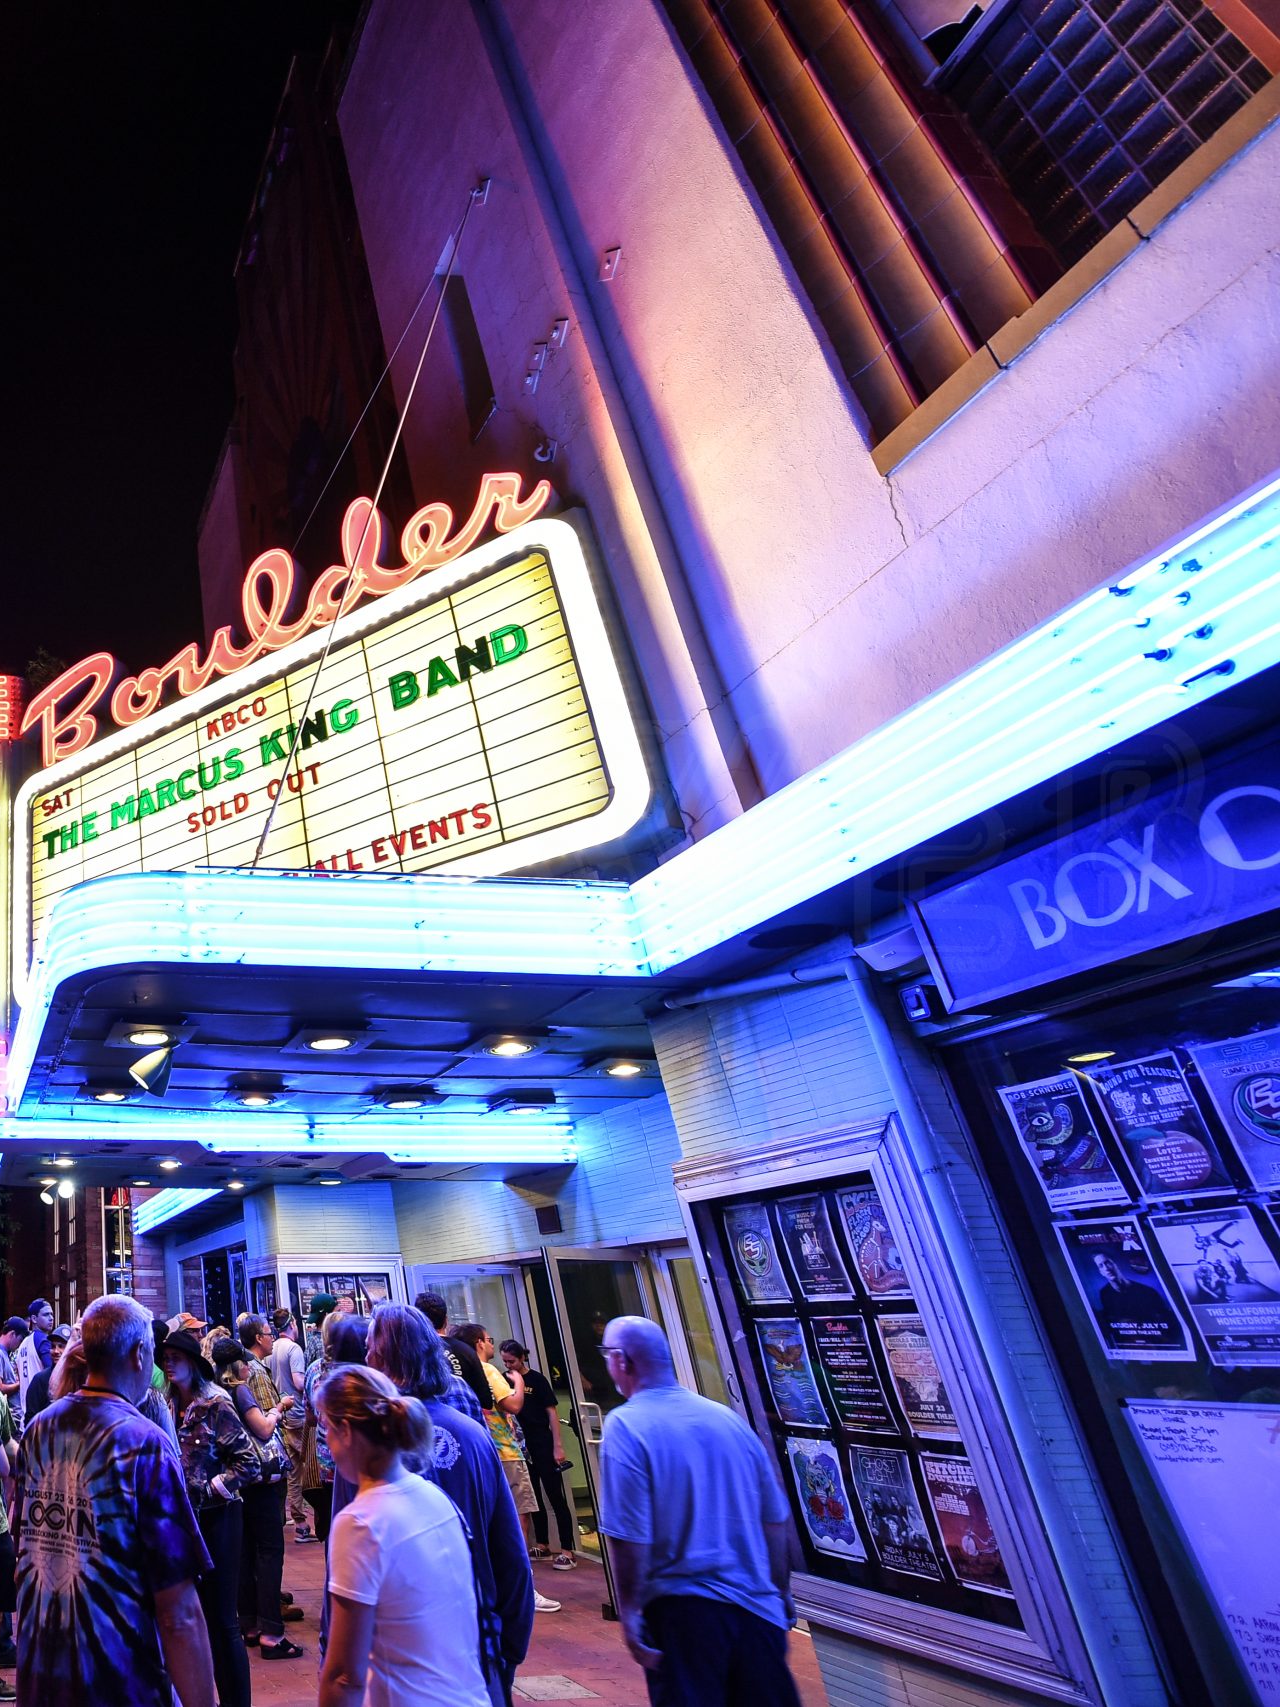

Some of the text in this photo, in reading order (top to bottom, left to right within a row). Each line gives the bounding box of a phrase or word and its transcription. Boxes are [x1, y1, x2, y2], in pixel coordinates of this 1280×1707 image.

[21, 472, 551, 769] Boulder
[42, 624, 529, 861] THE MARCUS KING BAND
[206, 697, 268, 740] KBCO
[41, 788, 74, 817] SAT
[187, 762, 321, 833] SOLD OUT
[371, 802, 493, 864] EVENTS
[1007, 823, 1195, 951] BOX
[1123, 1068, 1139, 1081] FOR
[1156, 1146, 1182, 1156] LOTUS
[1205, 1308, 1225, 1317] THE
